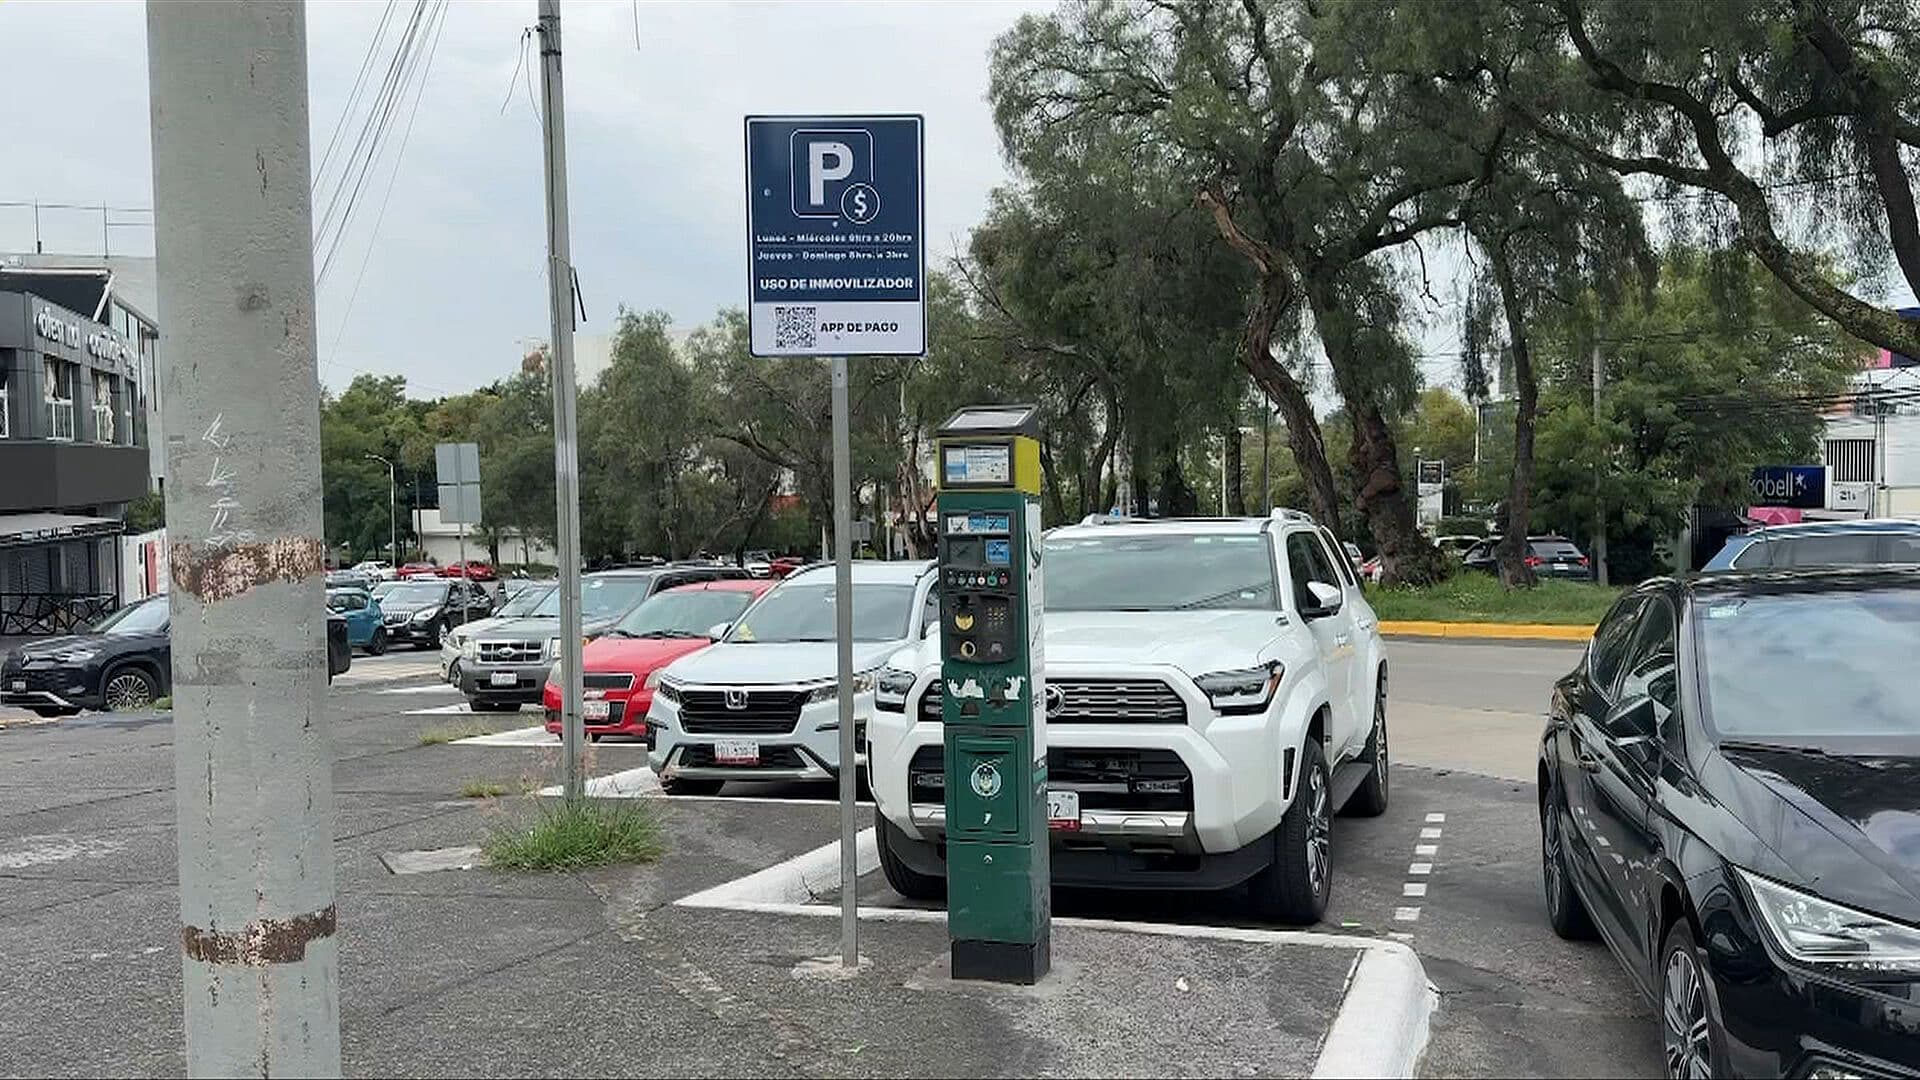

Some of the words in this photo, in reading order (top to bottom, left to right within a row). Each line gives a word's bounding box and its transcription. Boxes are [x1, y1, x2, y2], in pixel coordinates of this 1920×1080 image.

[809, 142, 854, 205] P
[854, 190, 868, 218] $
[756, 234, 787, 243] Lunes
[757, 251, 793, 260] Jueves
[802, 250, 847, 261] Domingo
[759, 279, 788, 289] USO
[790, 279, 807, 289] DE
[809, 278, 913, 289] INMOVILIZADOR
[820, 322, 844, 333] APP
[847, 322, 862, 333] DE
[865, 322, 899, 333] PAGO
